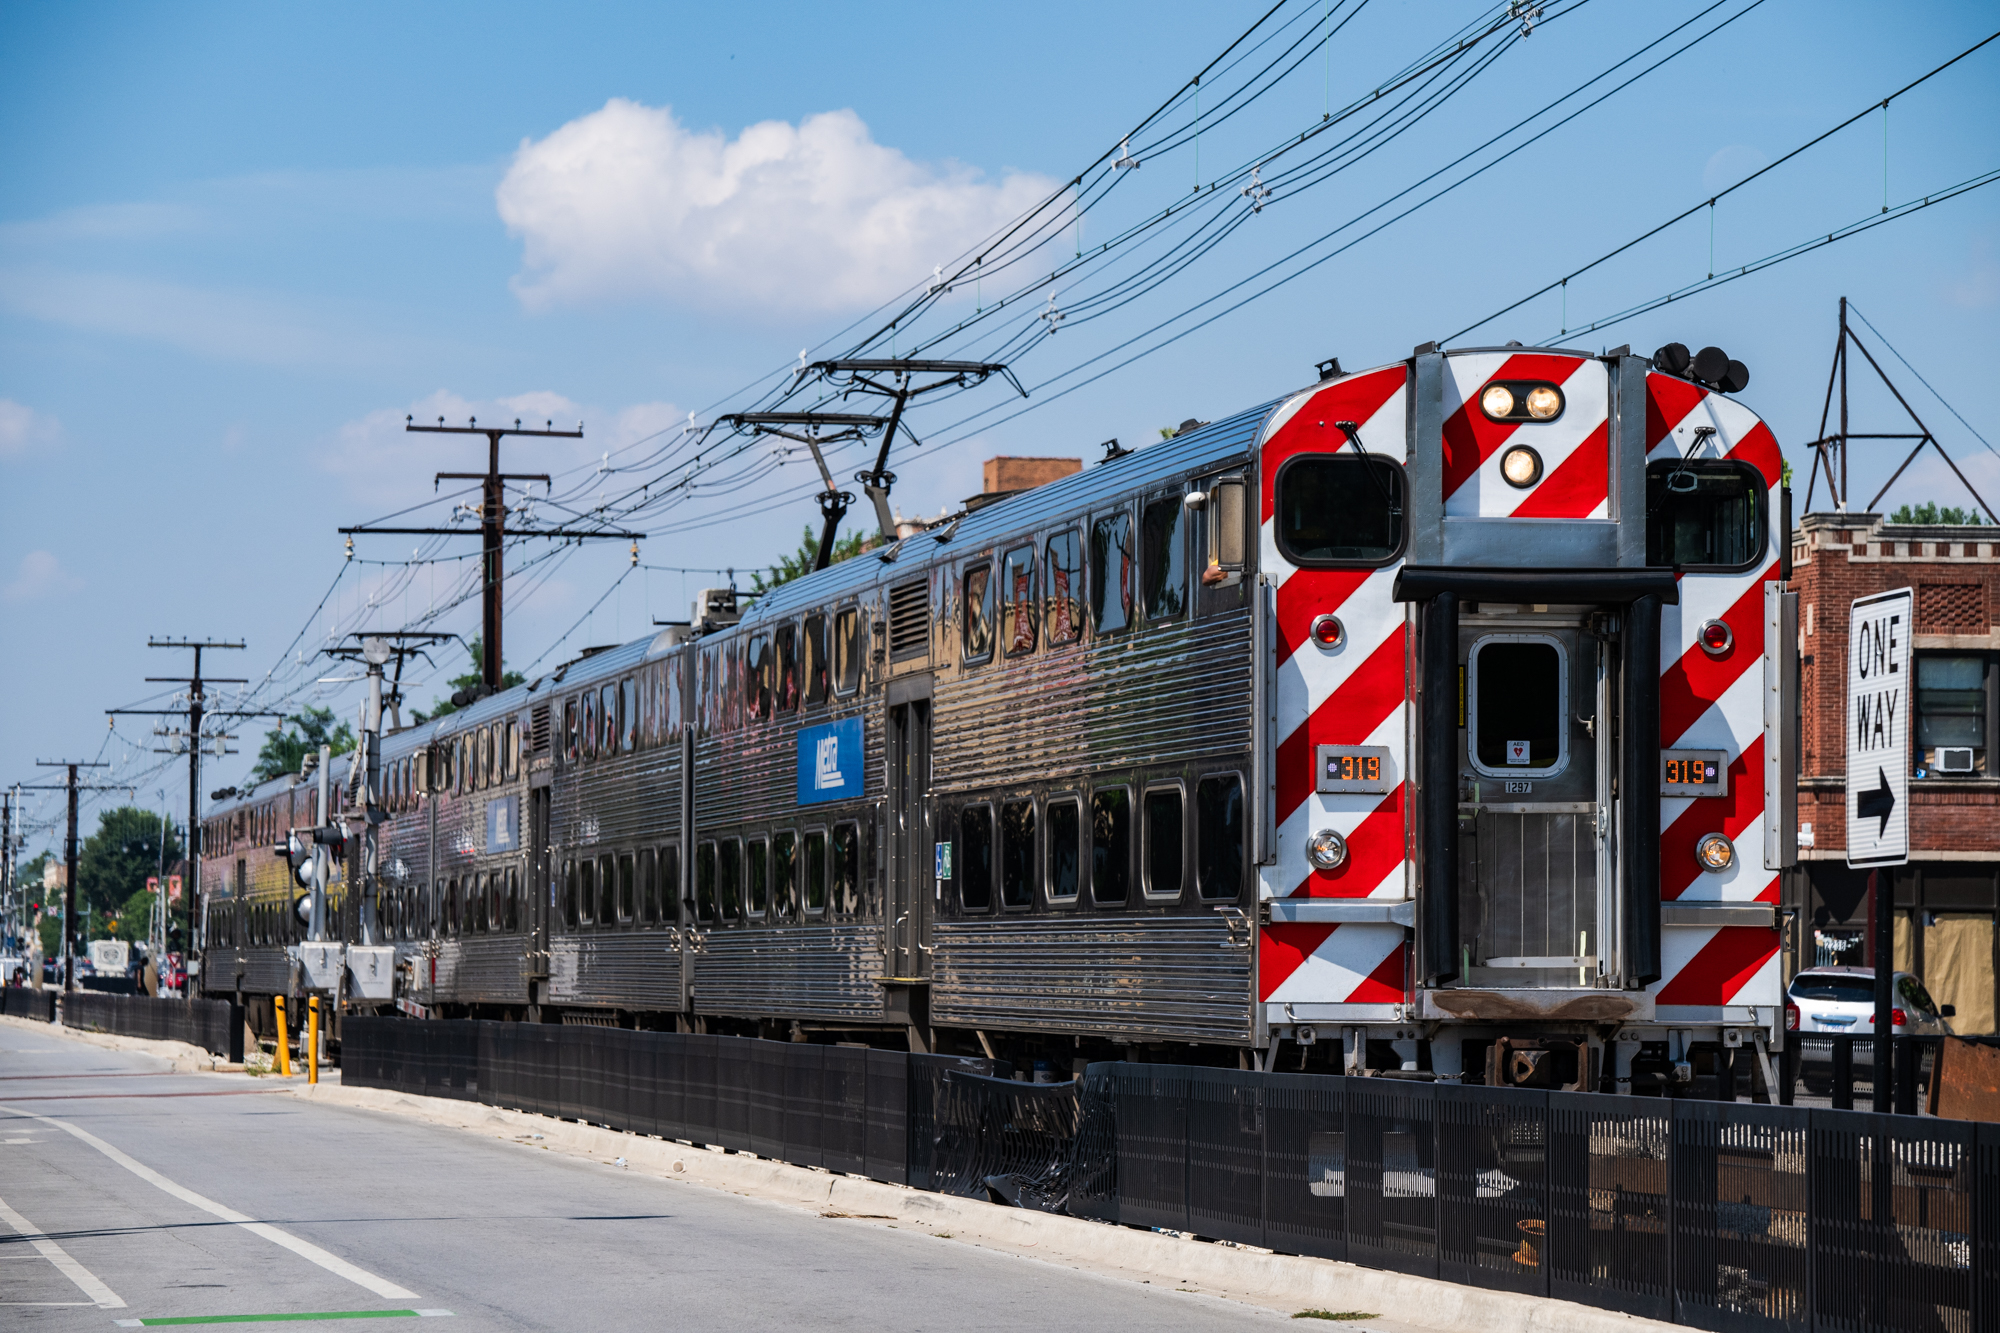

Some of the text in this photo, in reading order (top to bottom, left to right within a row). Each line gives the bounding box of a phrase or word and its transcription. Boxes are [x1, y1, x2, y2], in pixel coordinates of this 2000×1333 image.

[1859, 615, 1900, 679] ONE
[1857, 688, 1898, 752] WAY
[1341, 756, 1379, 780] 319
[1667, 760, 1704, 784] 319
[1508, 782, 1529, 793] 1297
